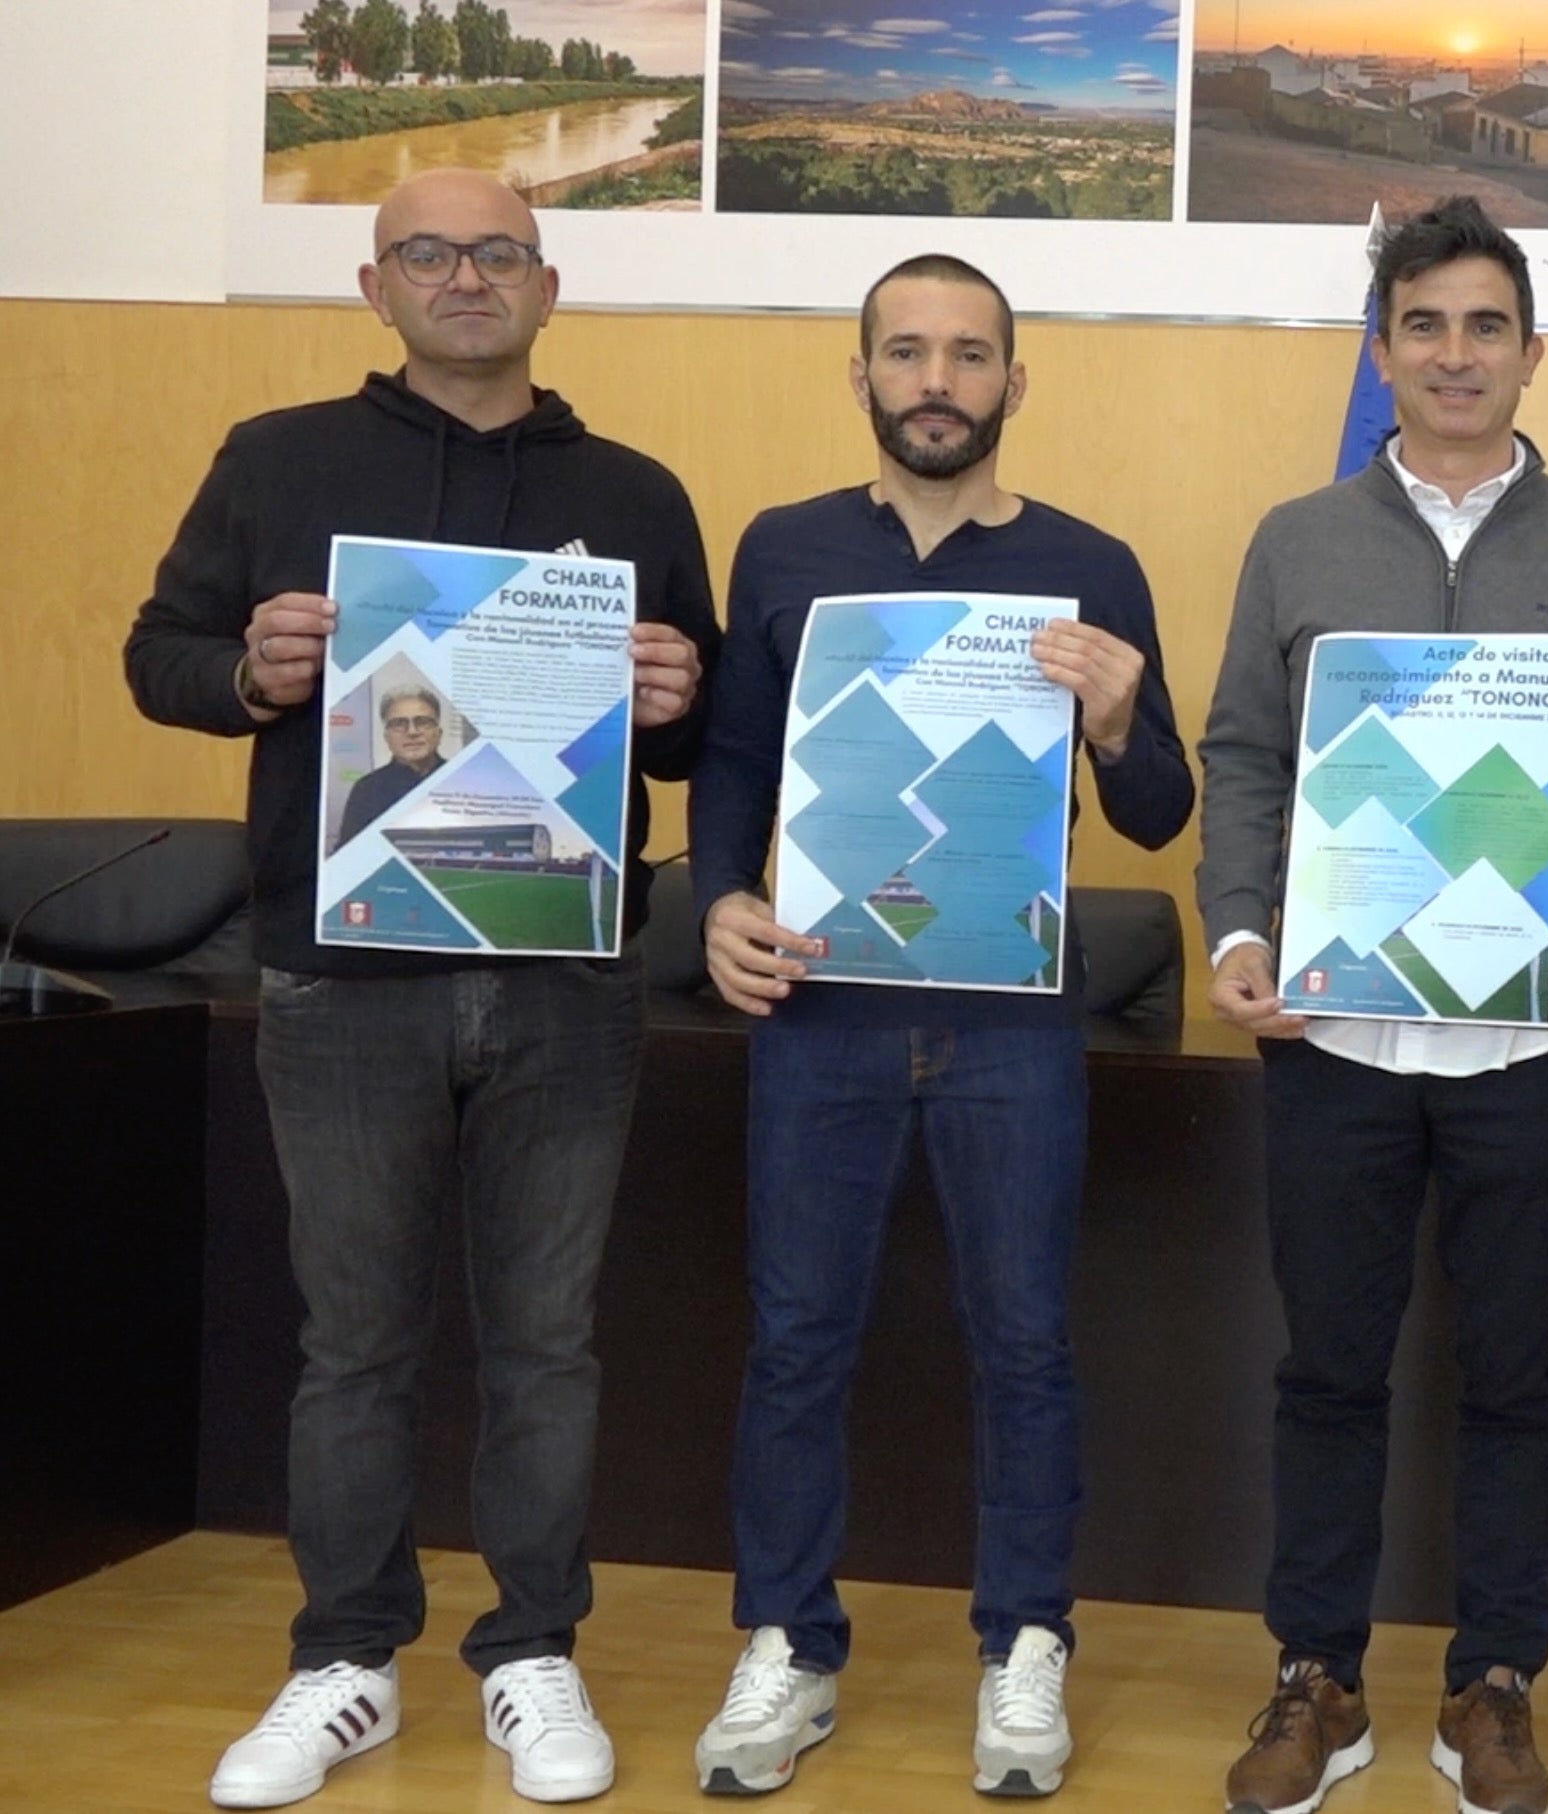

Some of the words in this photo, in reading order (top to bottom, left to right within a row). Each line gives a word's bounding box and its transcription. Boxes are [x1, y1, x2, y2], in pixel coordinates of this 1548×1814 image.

[542, 568, 626, 590] CHARLA
[499, 589, 626, 614] FORMATIVA
[985, 614, 1046, 631] CHARL
[945, 635, 1029, 654] FORMAT
[1423, 646, 1467, 661] Acto
[1473, 646, 1496, 661] de
[1327, 668, 1473, 683] reconocimiento
[1478, 673, 1490, 683] a
[1360, 687, 1454, 709] Rodríguez
